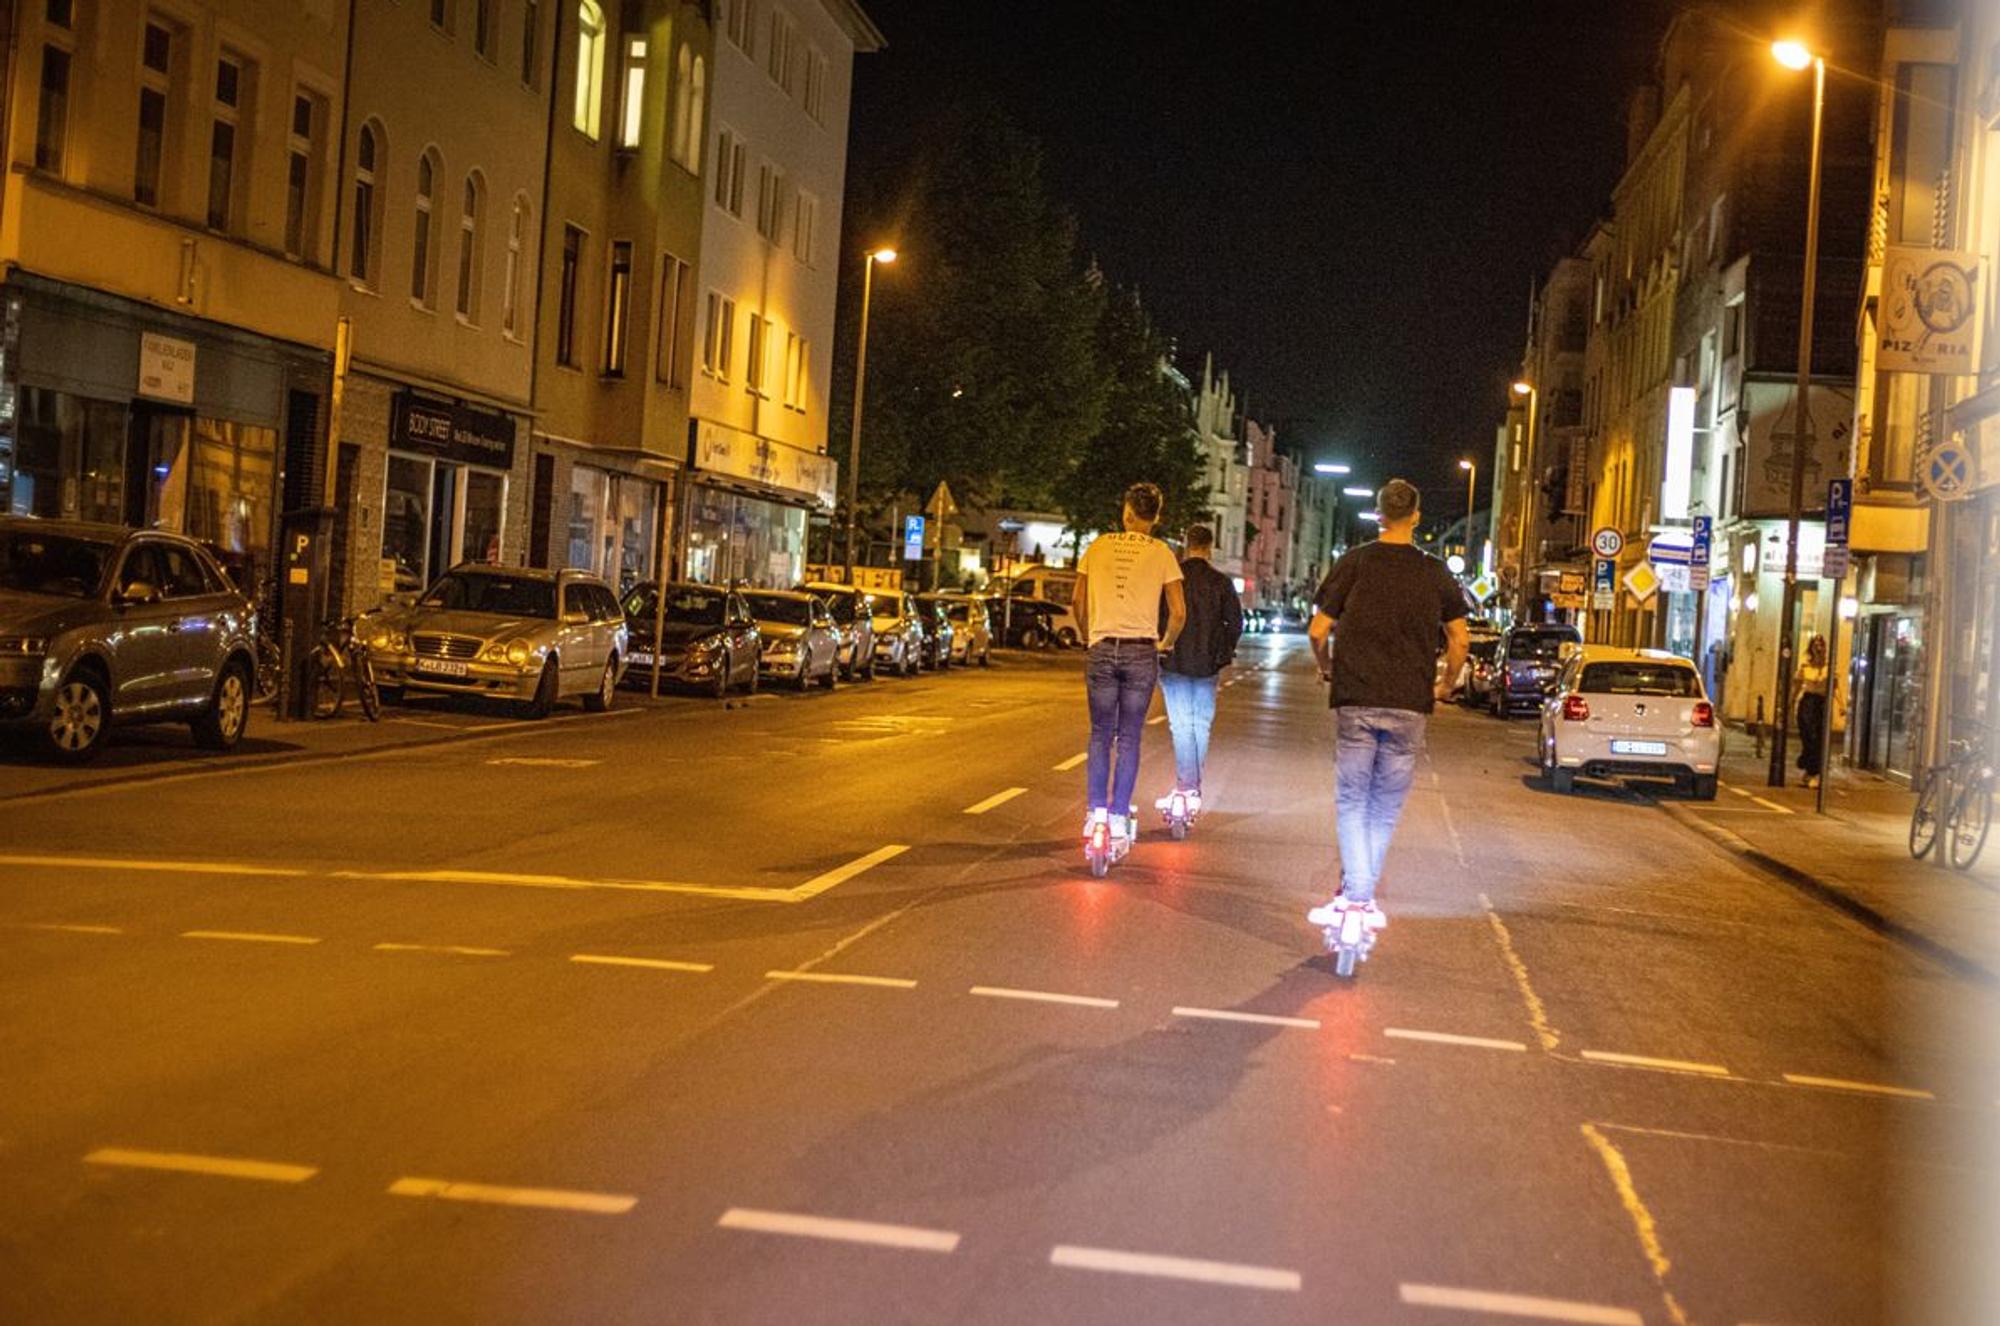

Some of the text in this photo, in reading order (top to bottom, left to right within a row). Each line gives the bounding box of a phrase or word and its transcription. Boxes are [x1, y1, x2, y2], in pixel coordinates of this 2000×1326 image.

[1882, 339, 1968, 355] PIZRIA
[1831, 482, 1843, 509] P
[297, 535, 309, 553] P
[1599, 535, 1617, 550] 30
[1598, 561, 1608, 576] P
